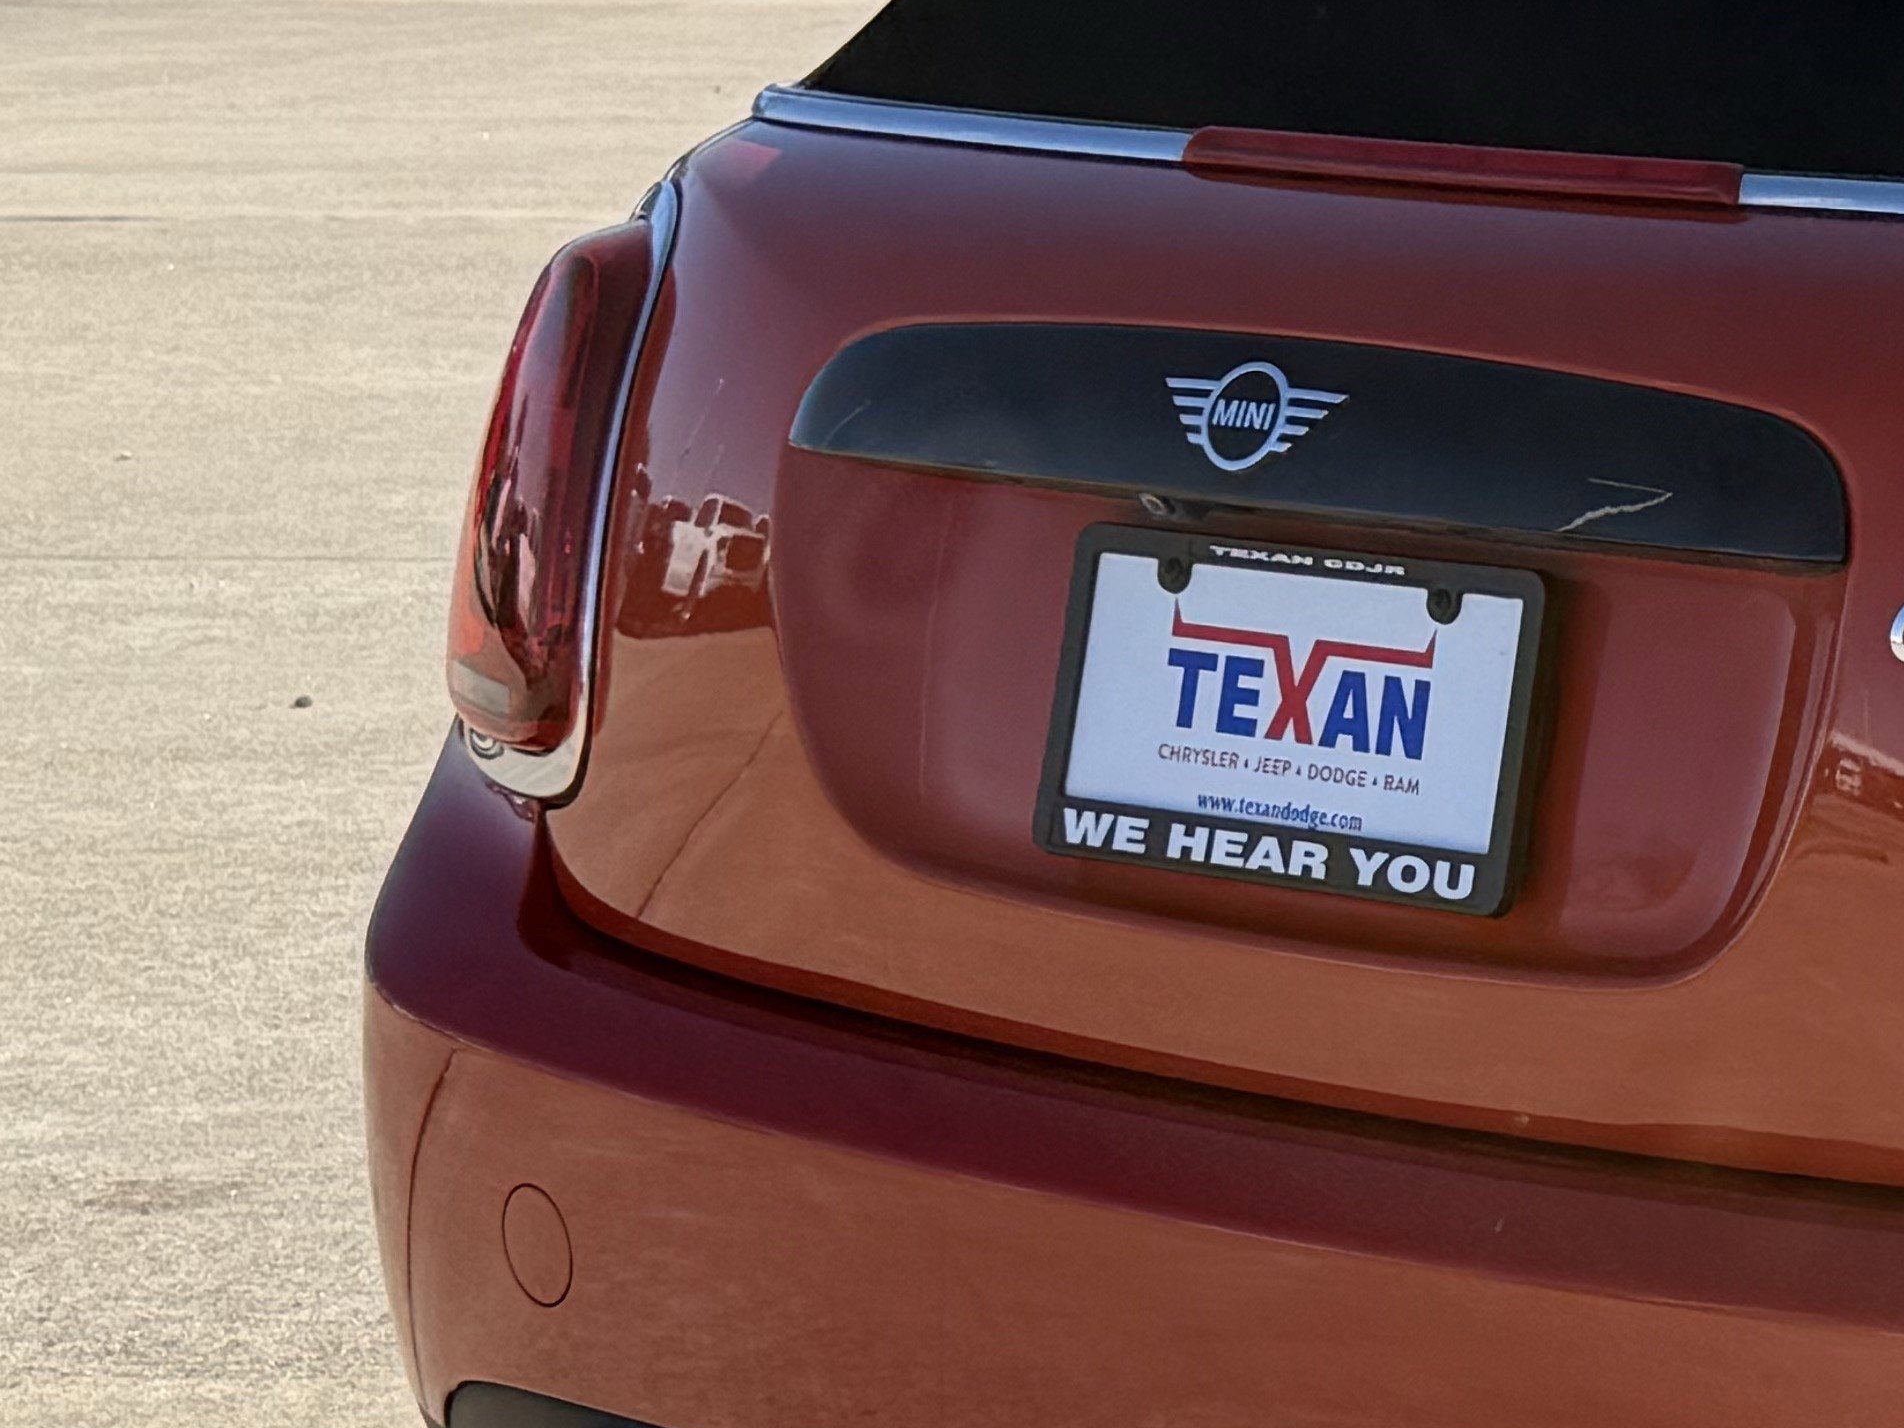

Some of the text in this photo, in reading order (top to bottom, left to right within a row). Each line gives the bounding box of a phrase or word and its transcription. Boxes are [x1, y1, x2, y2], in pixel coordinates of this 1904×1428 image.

[1212, 398, 1276, 431] MINI
[1209, 545, 1405, 576] TEXAN CDJR
[1168, 598, 1437, 760] TEXAN
[1158, 743, 1421, 796] CHRYSLER JEEP DODGE RAM
[1197, 793, 1363, 831] www.texandodge.com
[1062, 807, 1476, 902] WE HEAR YOU
